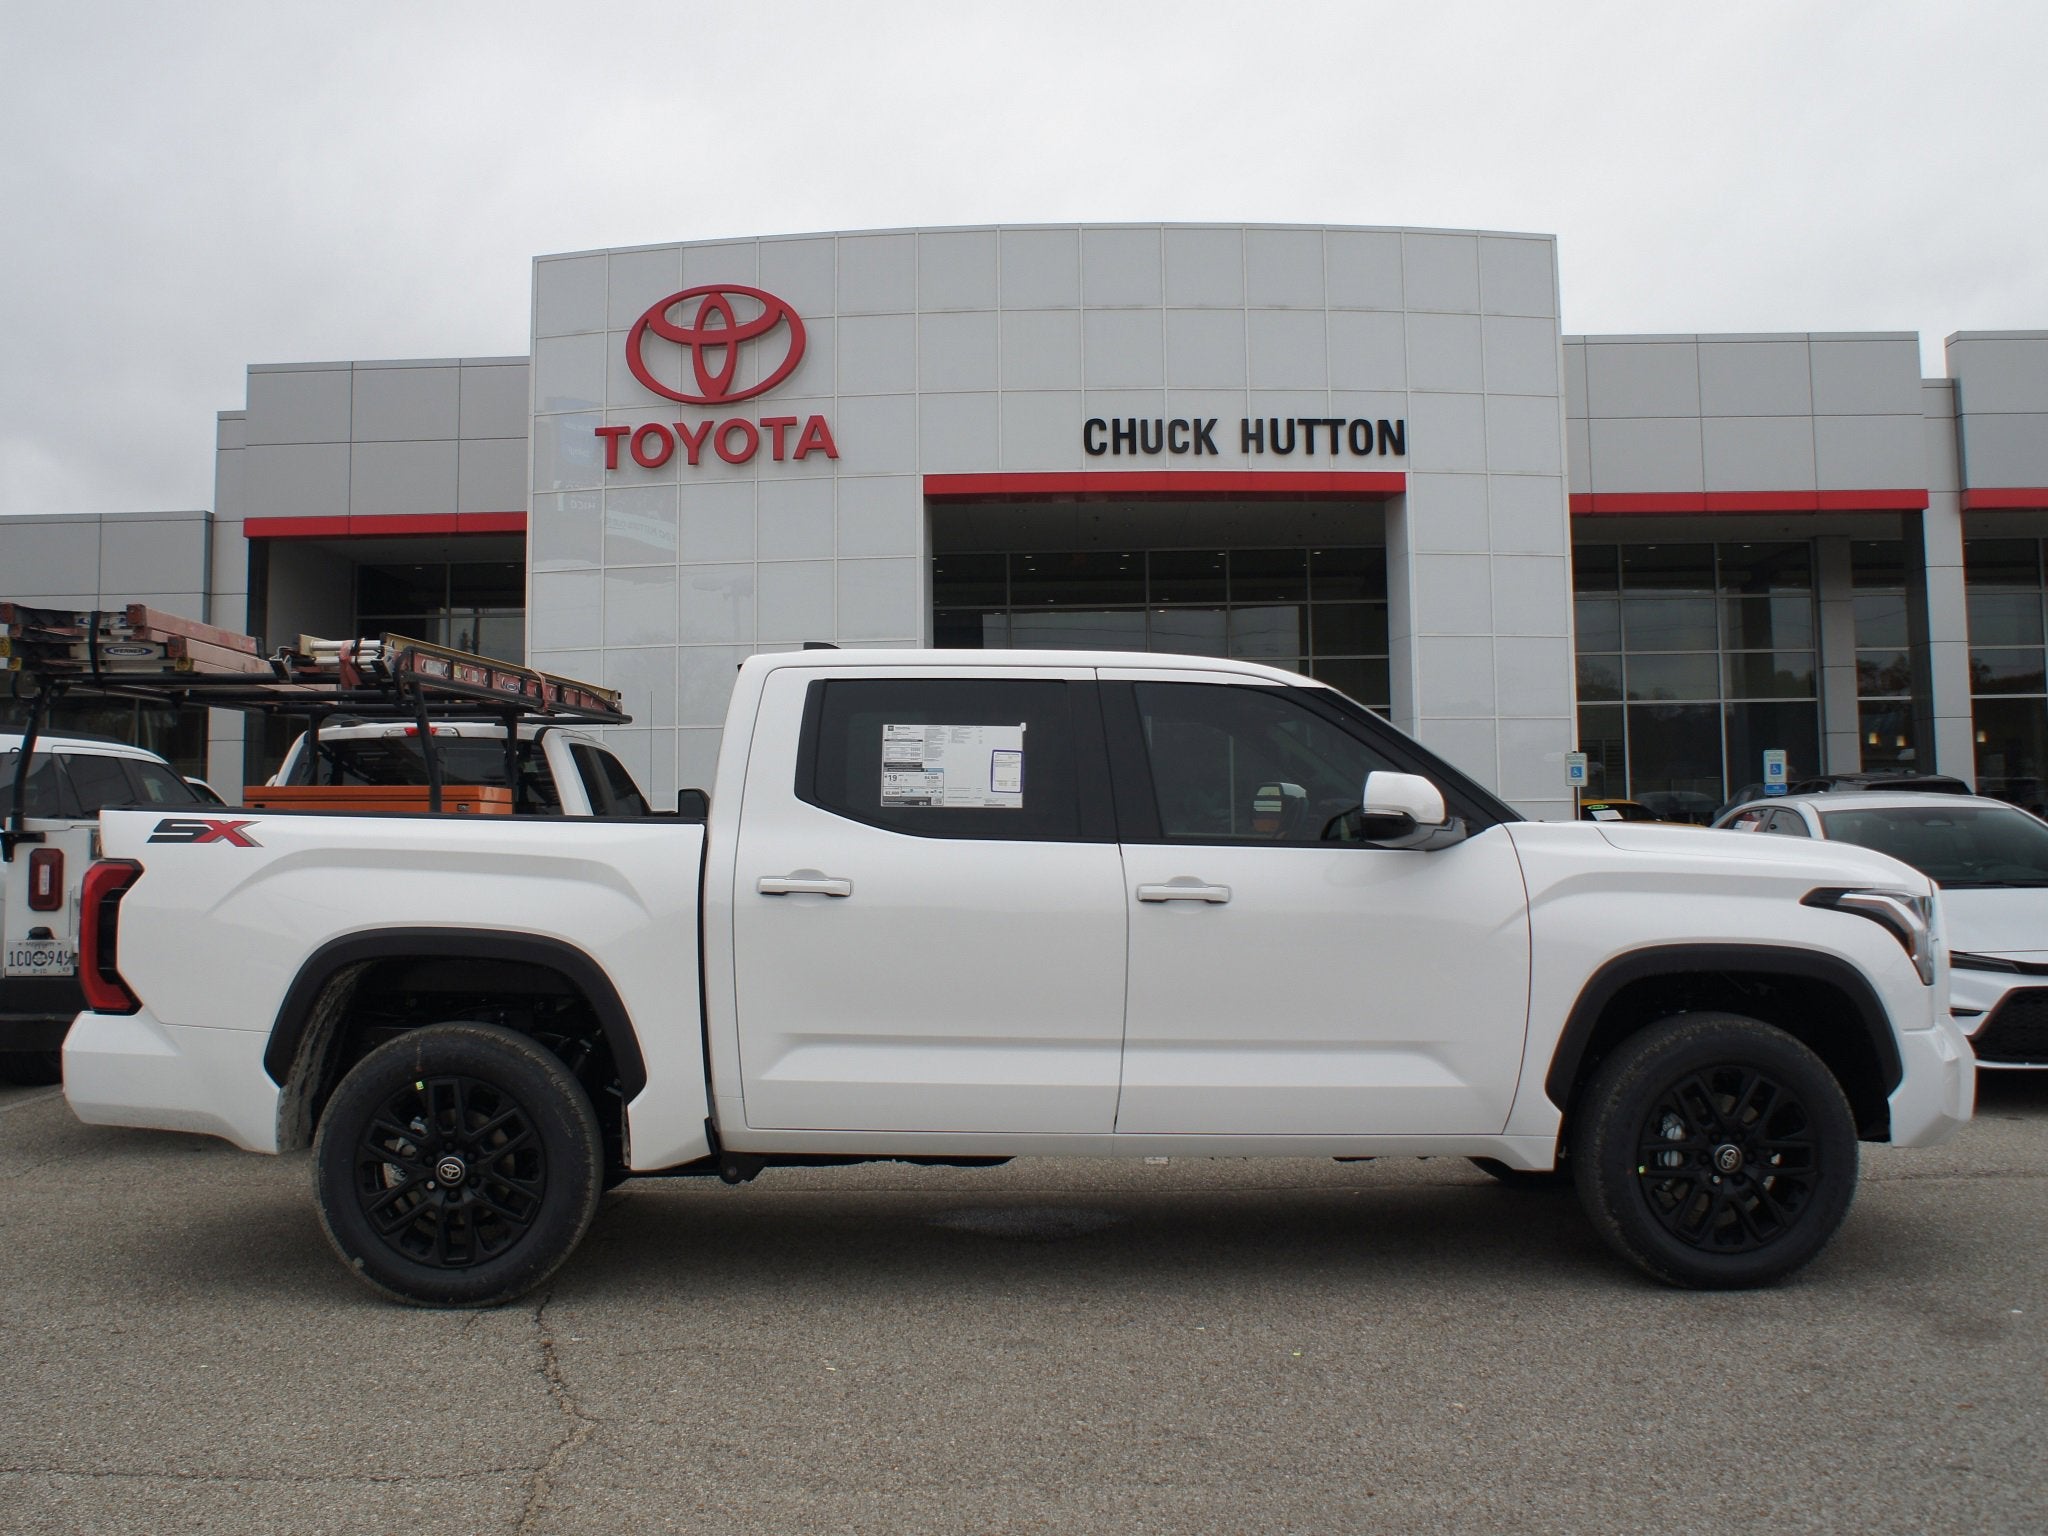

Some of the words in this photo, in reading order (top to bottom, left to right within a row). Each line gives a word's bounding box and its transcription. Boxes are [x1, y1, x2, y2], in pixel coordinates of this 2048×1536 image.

[594, 415, 839, 470] TOYOTA
[1083, 418, 1219, 455] CHUCK
[1241, 418, 1406, 456] HUTTON
[146, 818, 264, 848] SX
